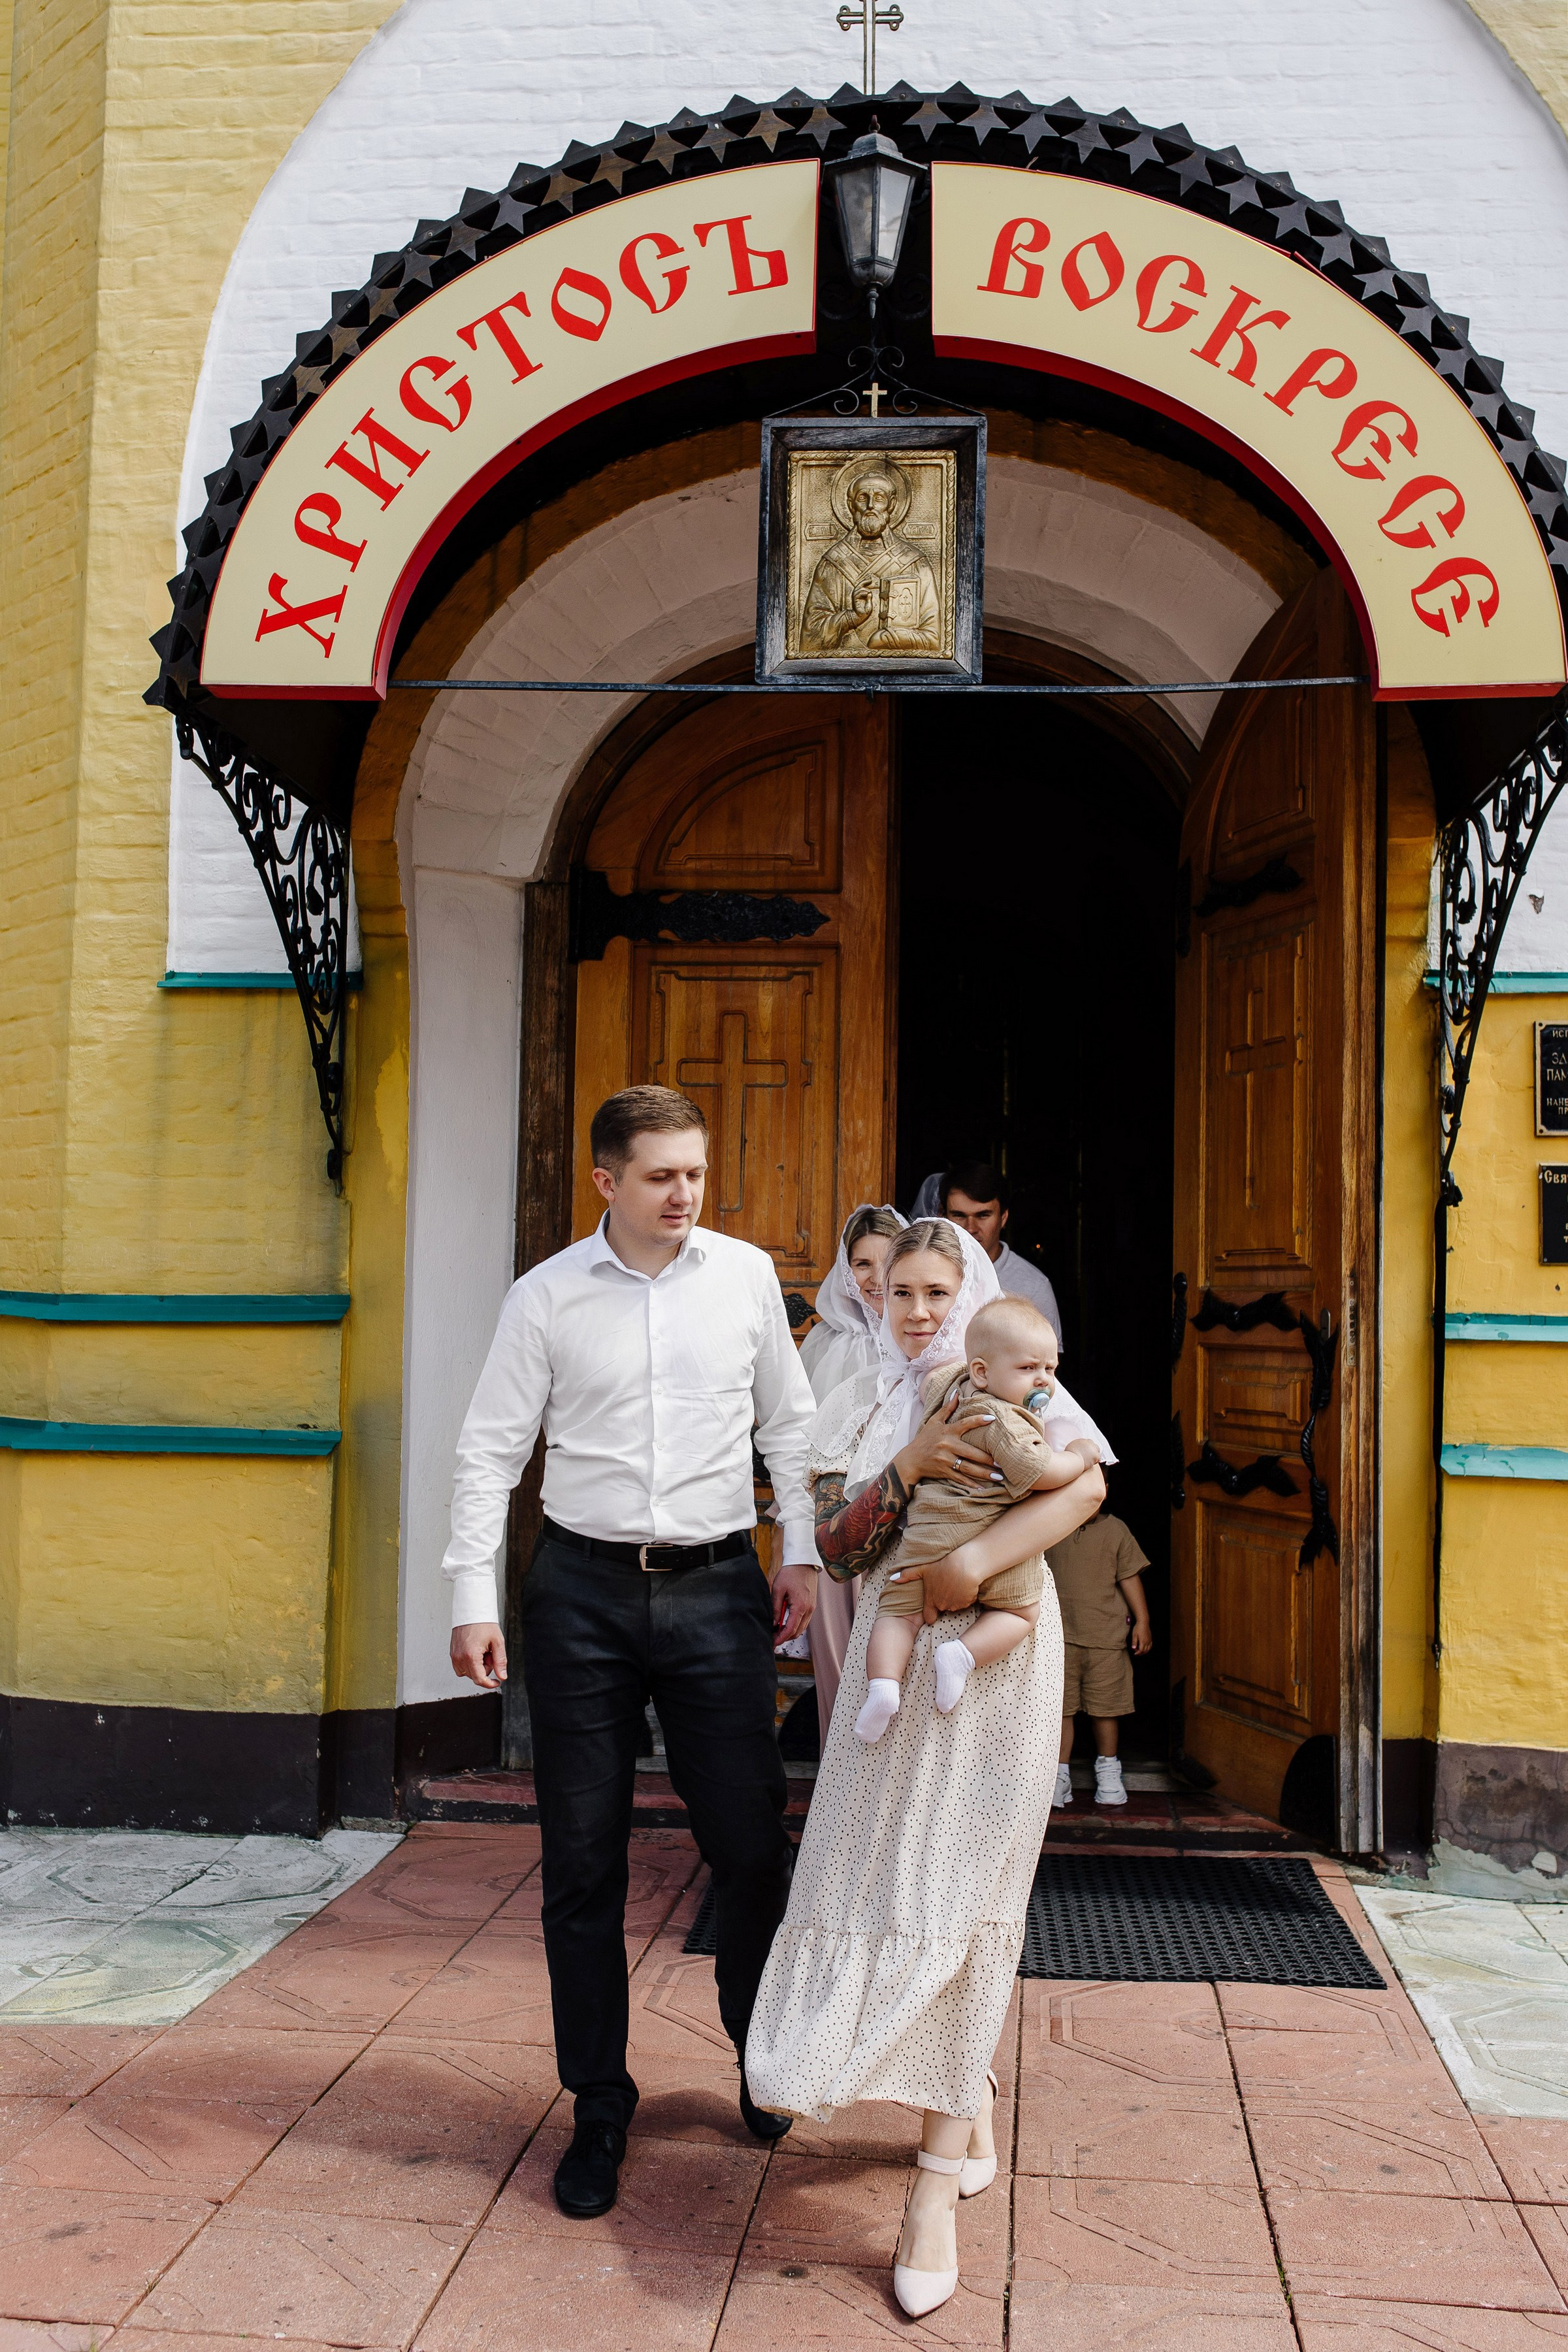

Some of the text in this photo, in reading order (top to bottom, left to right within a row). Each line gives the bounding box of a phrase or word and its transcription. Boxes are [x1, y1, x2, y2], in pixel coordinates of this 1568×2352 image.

[255, 215, 1500, 659] ХРИСТОСЪ ВОСКРЕСЕ
[1544, 1170, 1568, 1183] Свя
